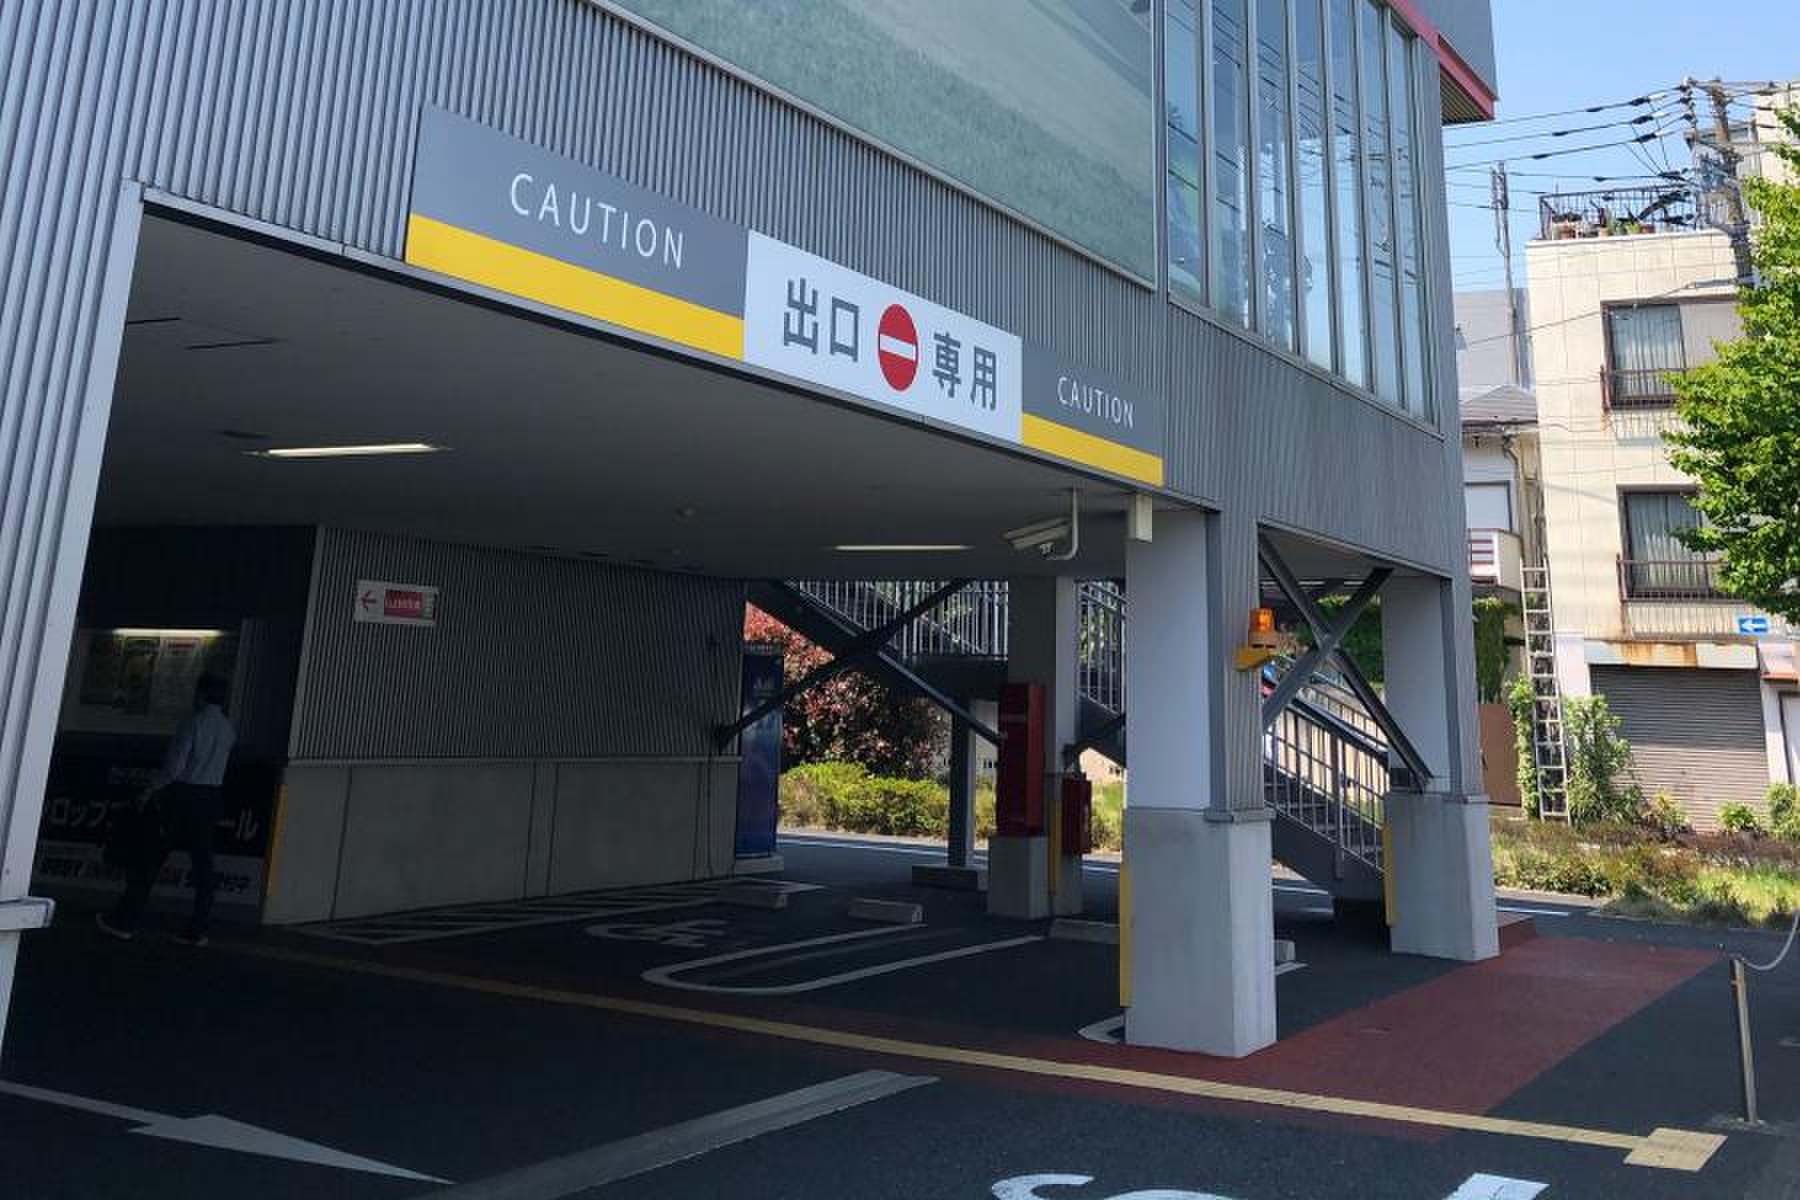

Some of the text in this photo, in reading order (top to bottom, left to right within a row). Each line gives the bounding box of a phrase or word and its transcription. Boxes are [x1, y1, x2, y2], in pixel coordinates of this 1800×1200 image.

[511, 174, 683, 268] CAUTION
[783, 277, 997, 411] 出口 専用
[1056, 375, 1135, 429] CAUTION
